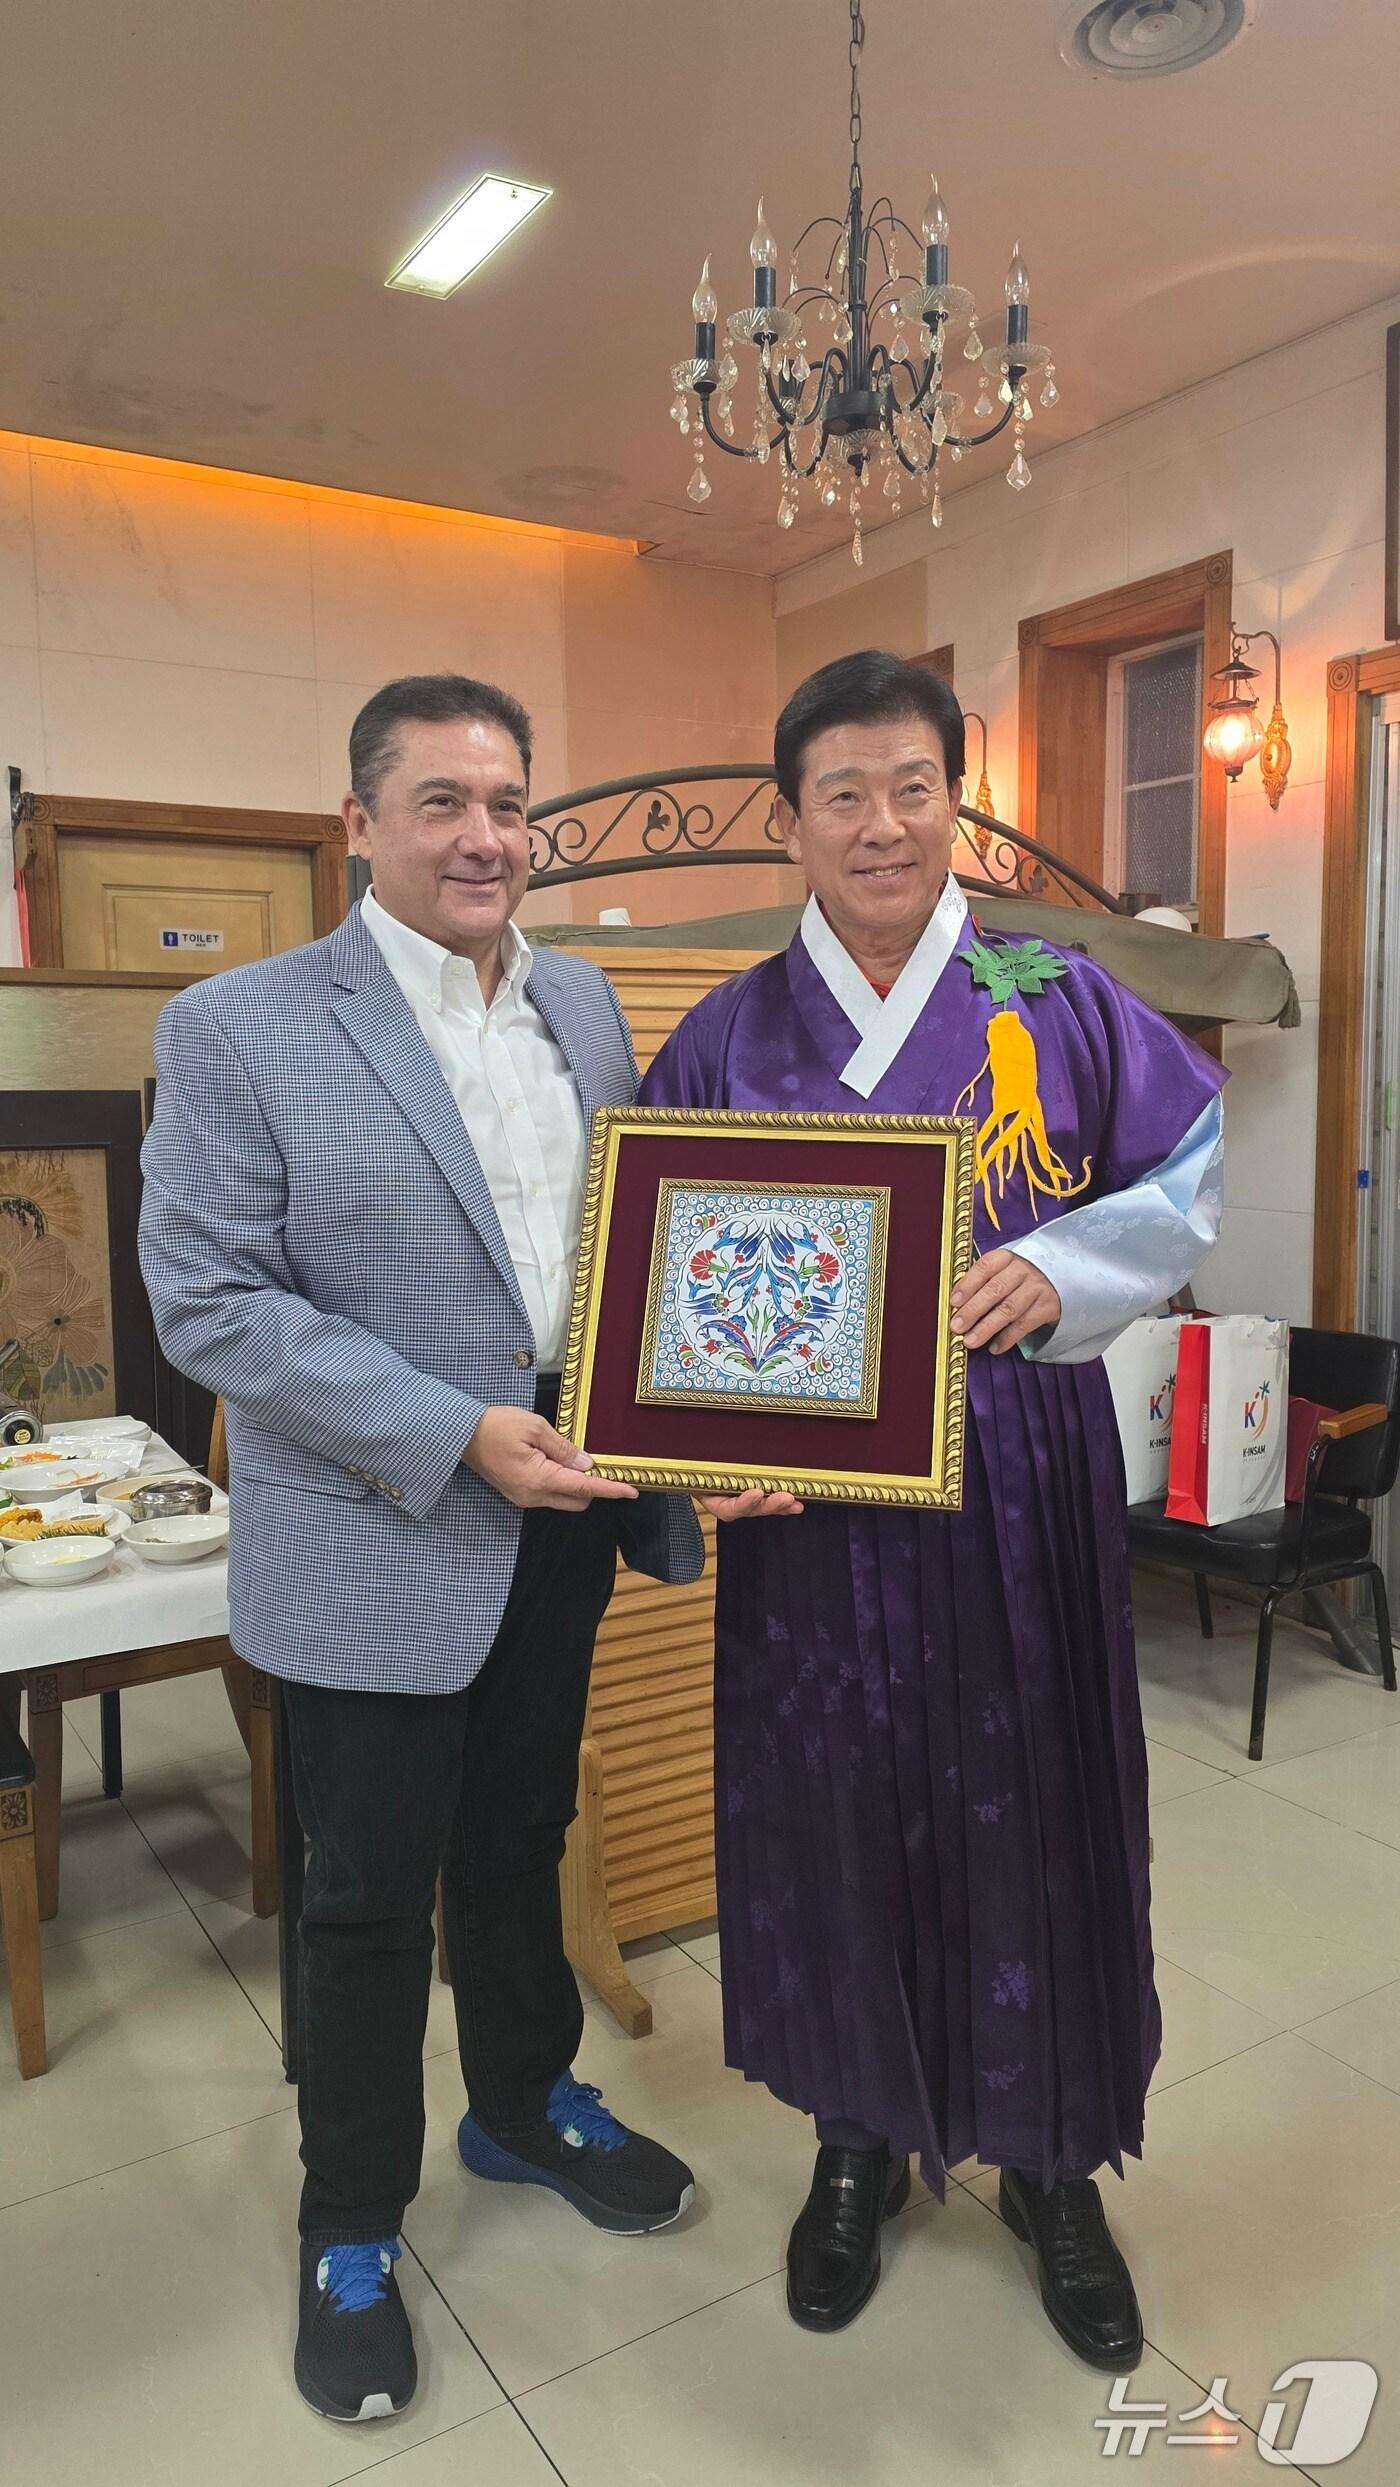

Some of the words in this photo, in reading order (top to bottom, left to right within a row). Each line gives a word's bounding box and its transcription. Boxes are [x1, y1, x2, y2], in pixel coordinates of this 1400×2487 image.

[182, 934, 219, 943] TOILET
[1150, 1394, 1163, 1421] K
[1244, 1400, 1256, 1429] K
[1150, 1437, 1171, 1448] K-INSA
[1243, 1445, 1266, 1457] K-INSAM
